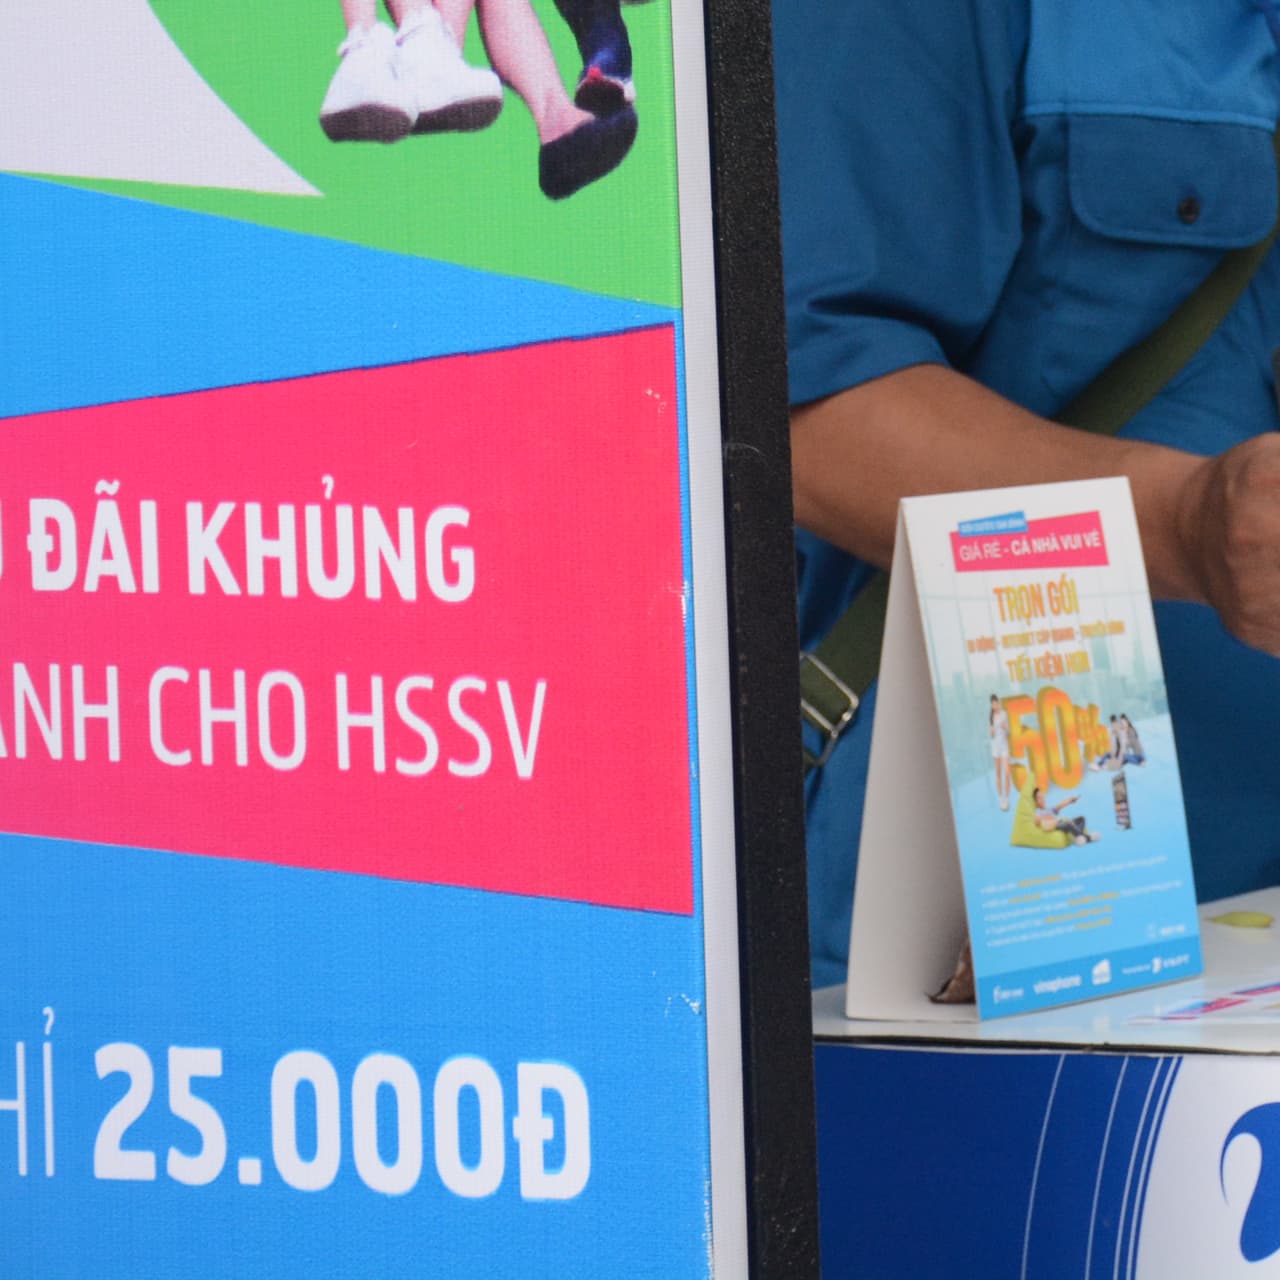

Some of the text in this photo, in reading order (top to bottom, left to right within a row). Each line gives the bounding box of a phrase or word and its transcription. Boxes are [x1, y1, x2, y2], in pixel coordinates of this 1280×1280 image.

[27, 474, 477, 603] ĐÃI KHỦNG
[0, 662, 548, 780] NH CHO HSSV
[1000, 685, 1112, 798] 50%
[93, 1041, 592, 1200] 25.000Đ
